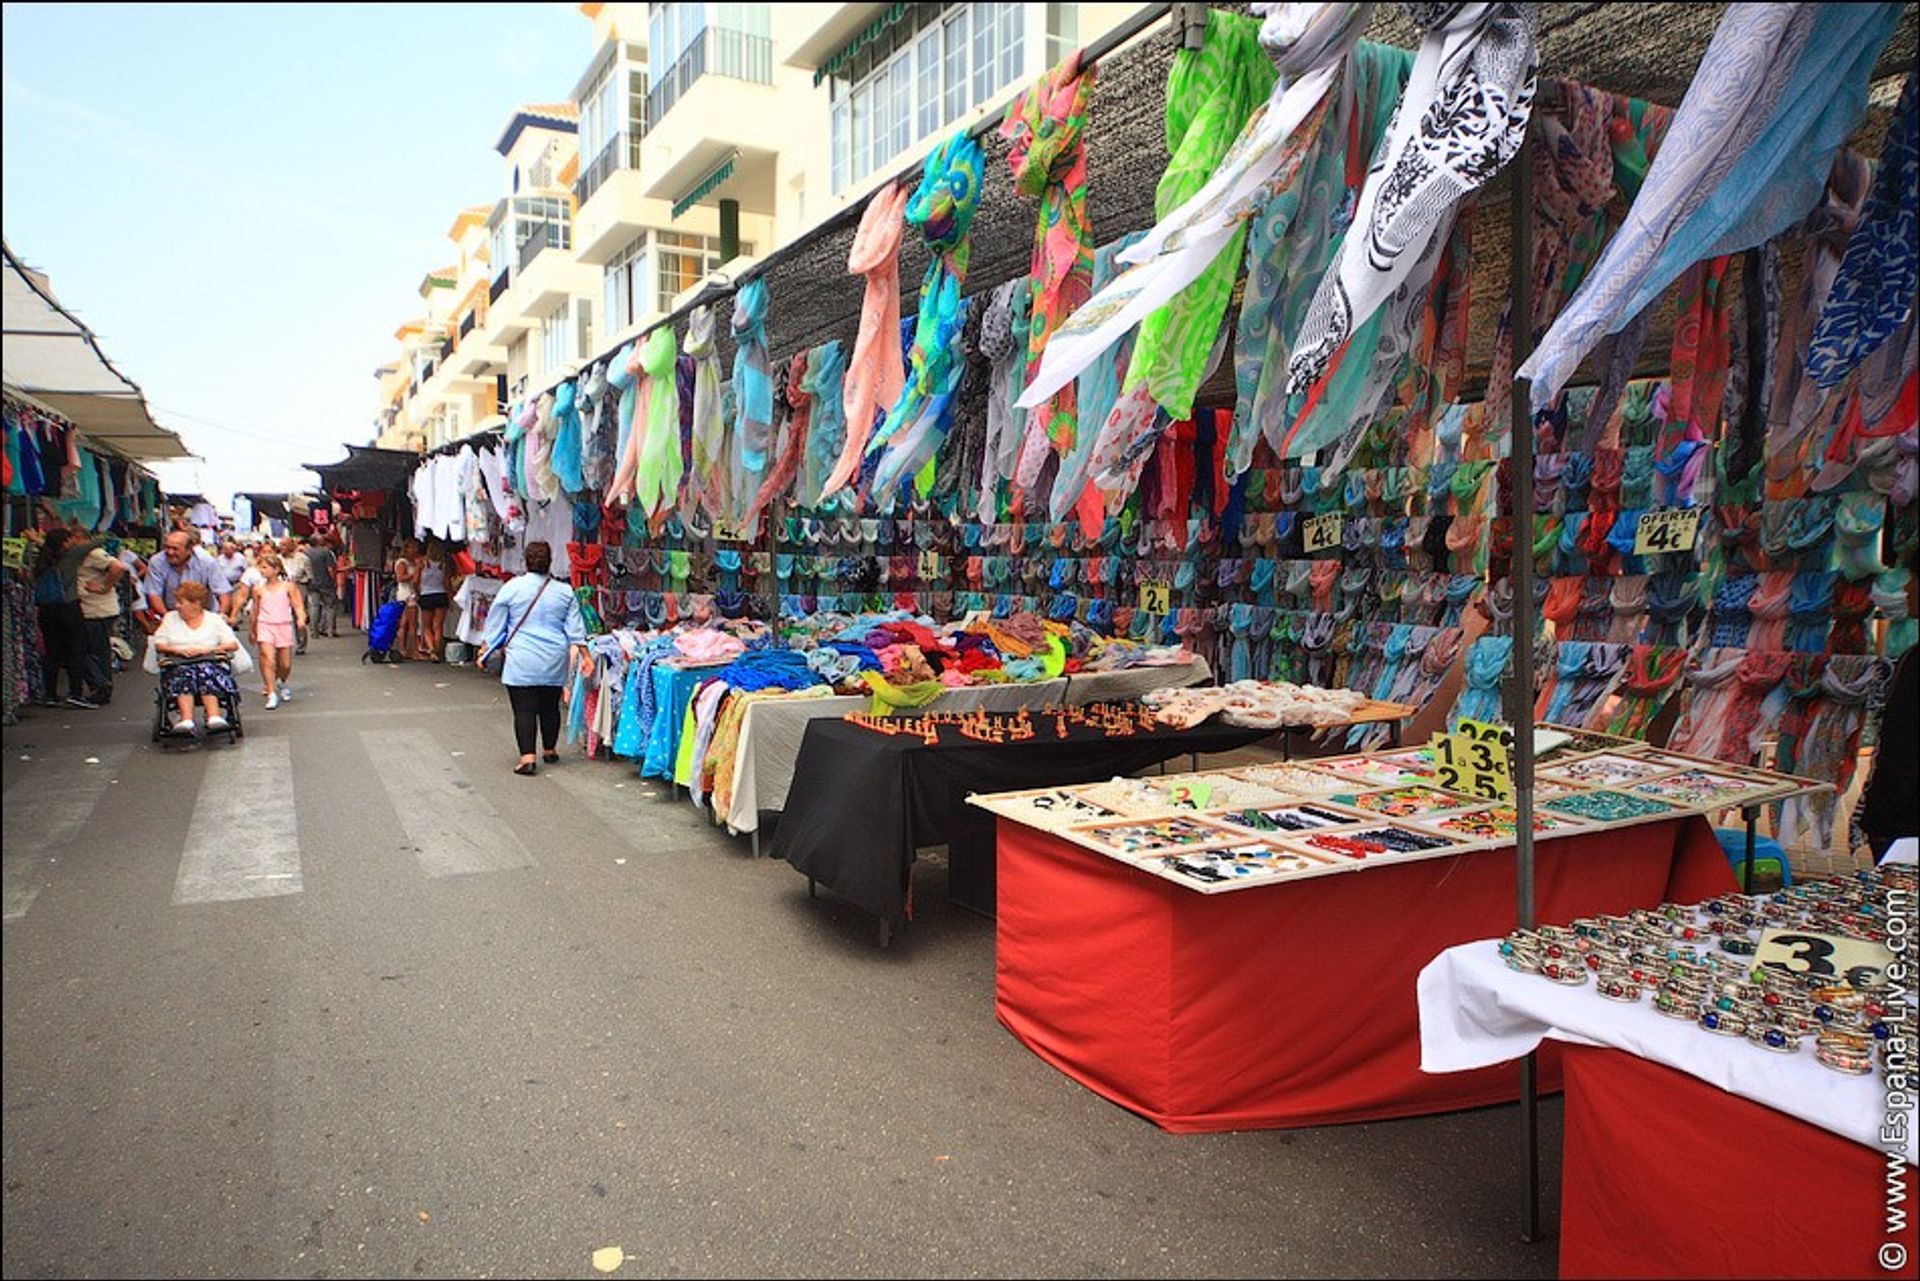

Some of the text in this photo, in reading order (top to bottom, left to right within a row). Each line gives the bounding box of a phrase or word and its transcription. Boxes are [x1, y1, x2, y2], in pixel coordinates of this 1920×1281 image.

[1641, 510, 1697, 524] OFERTA
[1647, 523, 1682, 550] 4€
[1438, 738, 1453, 765] 1
[1471, 743, 1505, 775] 3€
[1763, 935, 1880, 989] 3€
